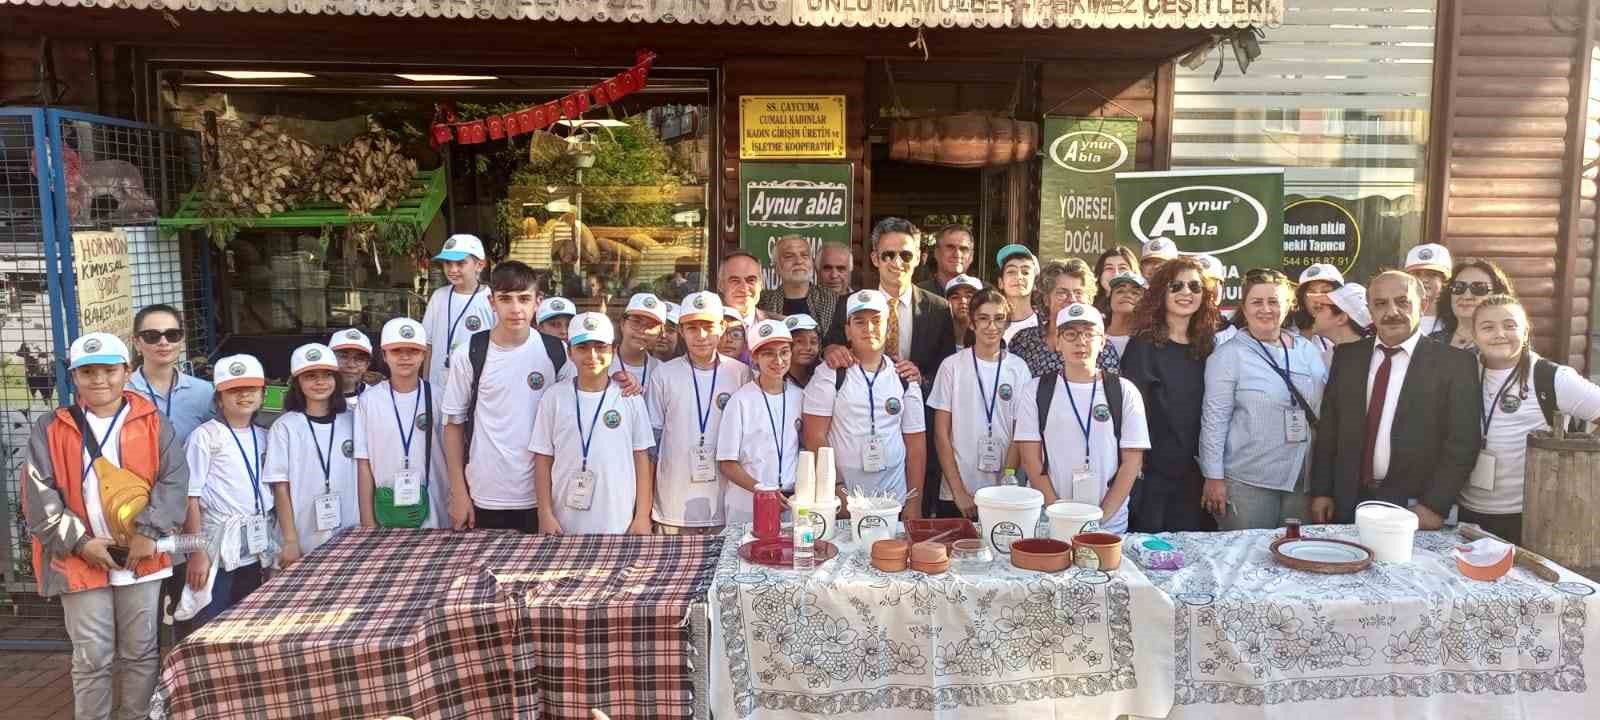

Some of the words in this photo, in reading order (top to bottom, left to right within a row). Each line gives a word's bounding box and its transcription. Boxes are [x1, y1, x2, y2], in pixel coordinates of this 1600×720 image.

[781, 101, 820, 113] ÇAYCUMA
[789, 114, 827, 125] KADINLAR
[751, 191, 803, 221] Aynur
[805, 191, 842, 215] abla
[1059, 189, 1115, 221] YÖRESEL
[1283, 223, 1319, 235] Burhan
[1320, 220, 1346, 235] BİLİR
[79, 238, 128, 261] HORMON
[1064, 226, 1106, 255] DOĞAL
[1309, 239, 1346, 253] Tapucu
